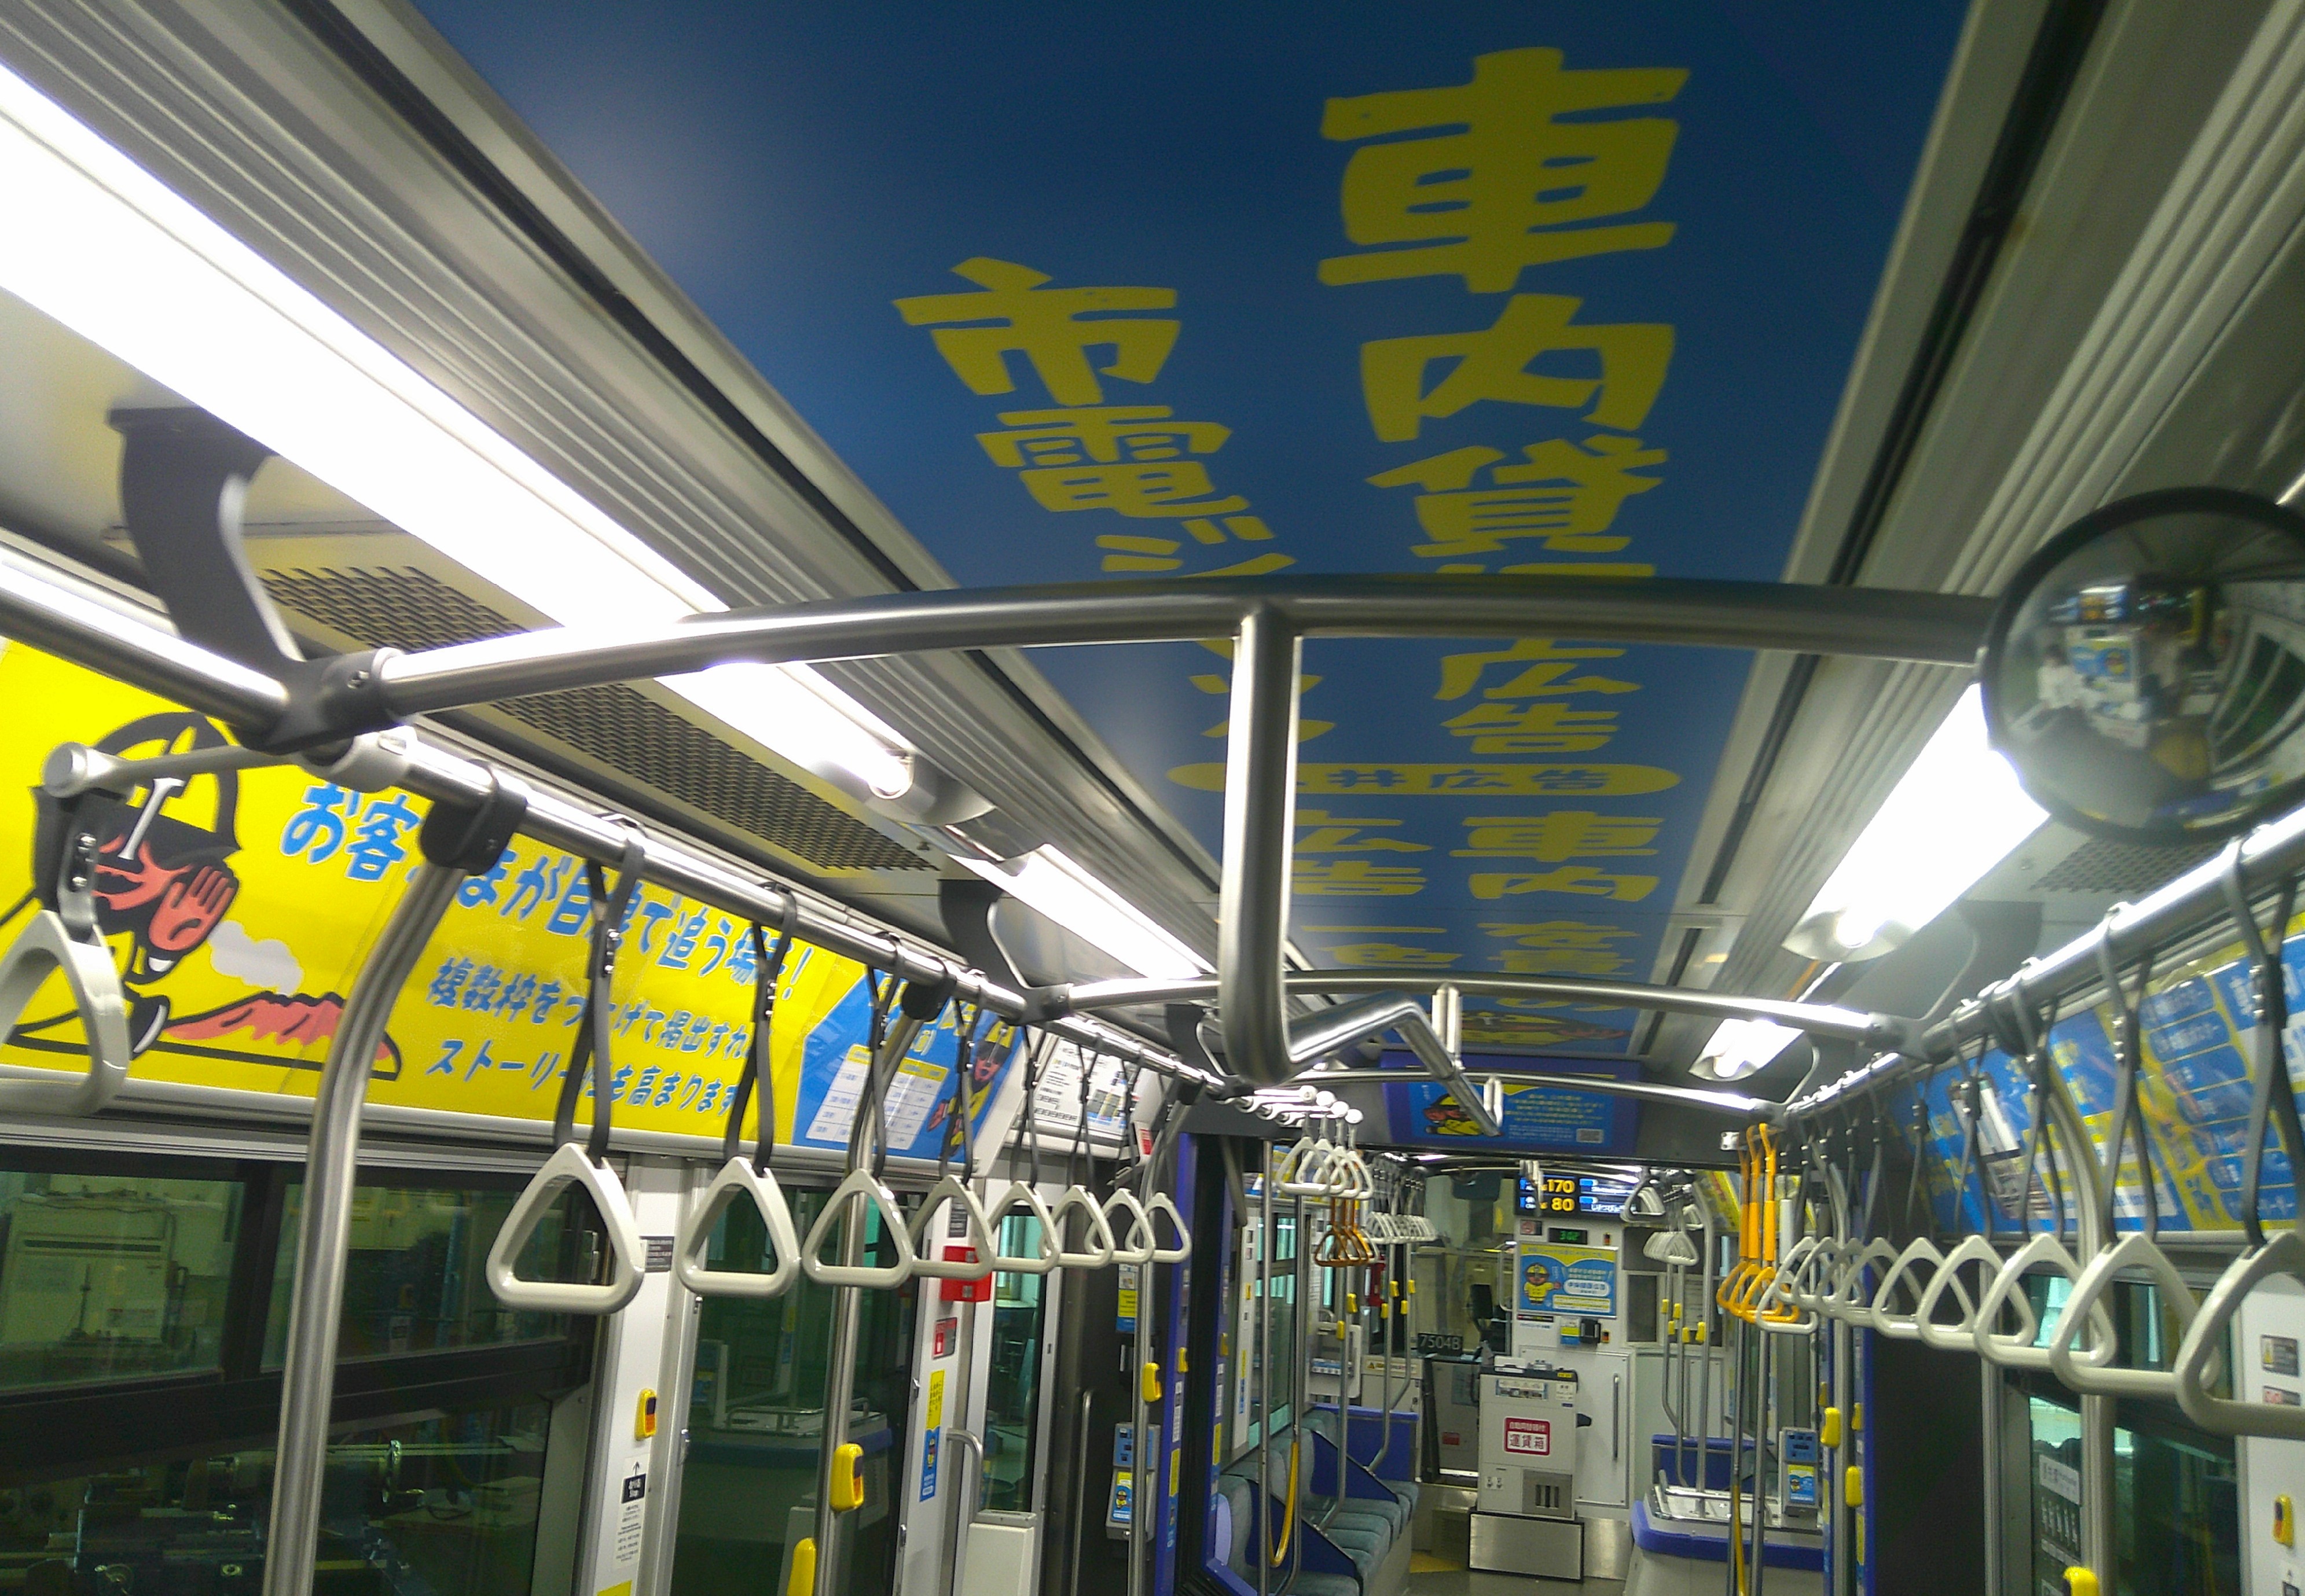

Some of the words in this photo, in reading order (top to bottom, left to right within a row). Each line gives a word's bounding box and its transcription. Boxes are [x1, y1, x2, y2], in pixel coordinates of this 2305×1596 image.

[1317, 46, 1690, 754] 車内貸広告
[1295, 768, 1612, 792] 井広告
[1551, 1197, 1575, 1212] 80
[1418, 1334, 1461, 1350] 7504B
